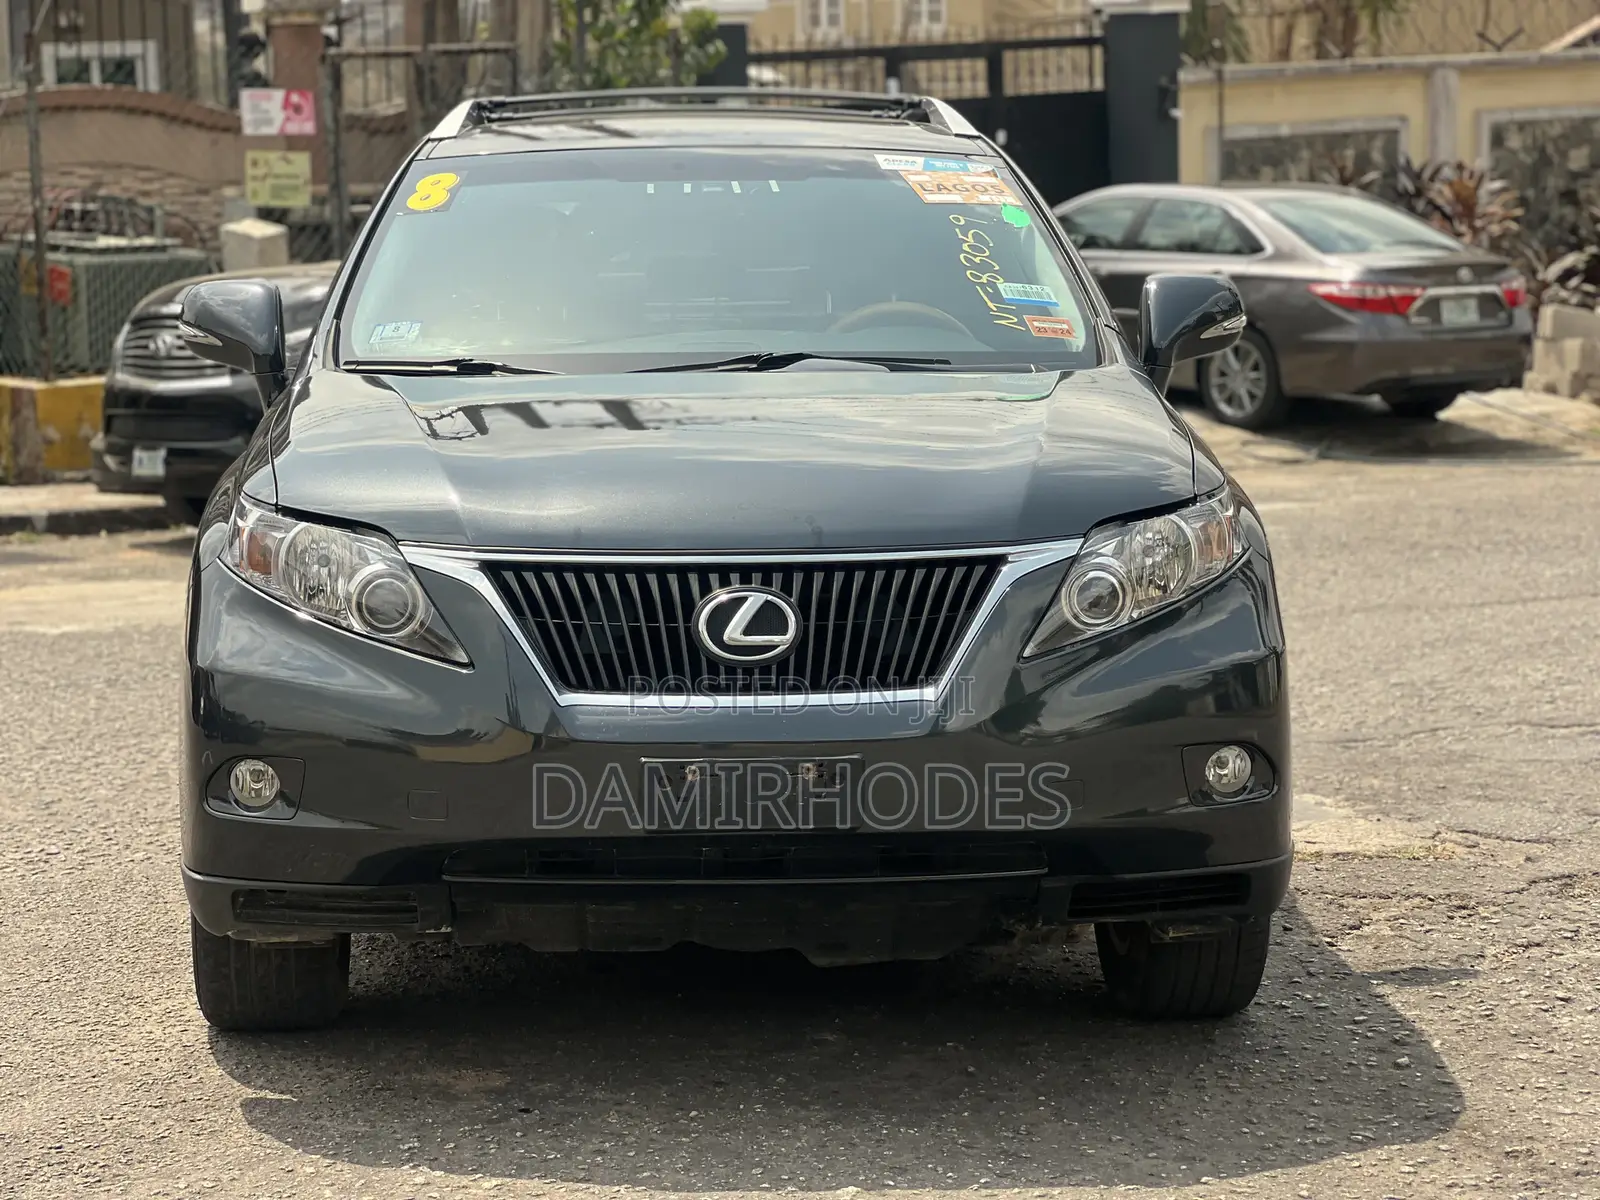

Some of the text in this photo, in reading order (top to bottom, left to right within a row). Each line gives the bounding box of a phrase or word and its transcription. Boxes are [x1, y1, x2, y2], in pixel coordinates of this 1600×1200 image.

[406, 173, 460, 211] 8
[918, 182, 1005, 194] LAGOS
[1059, 328, 1072, 336] 24
